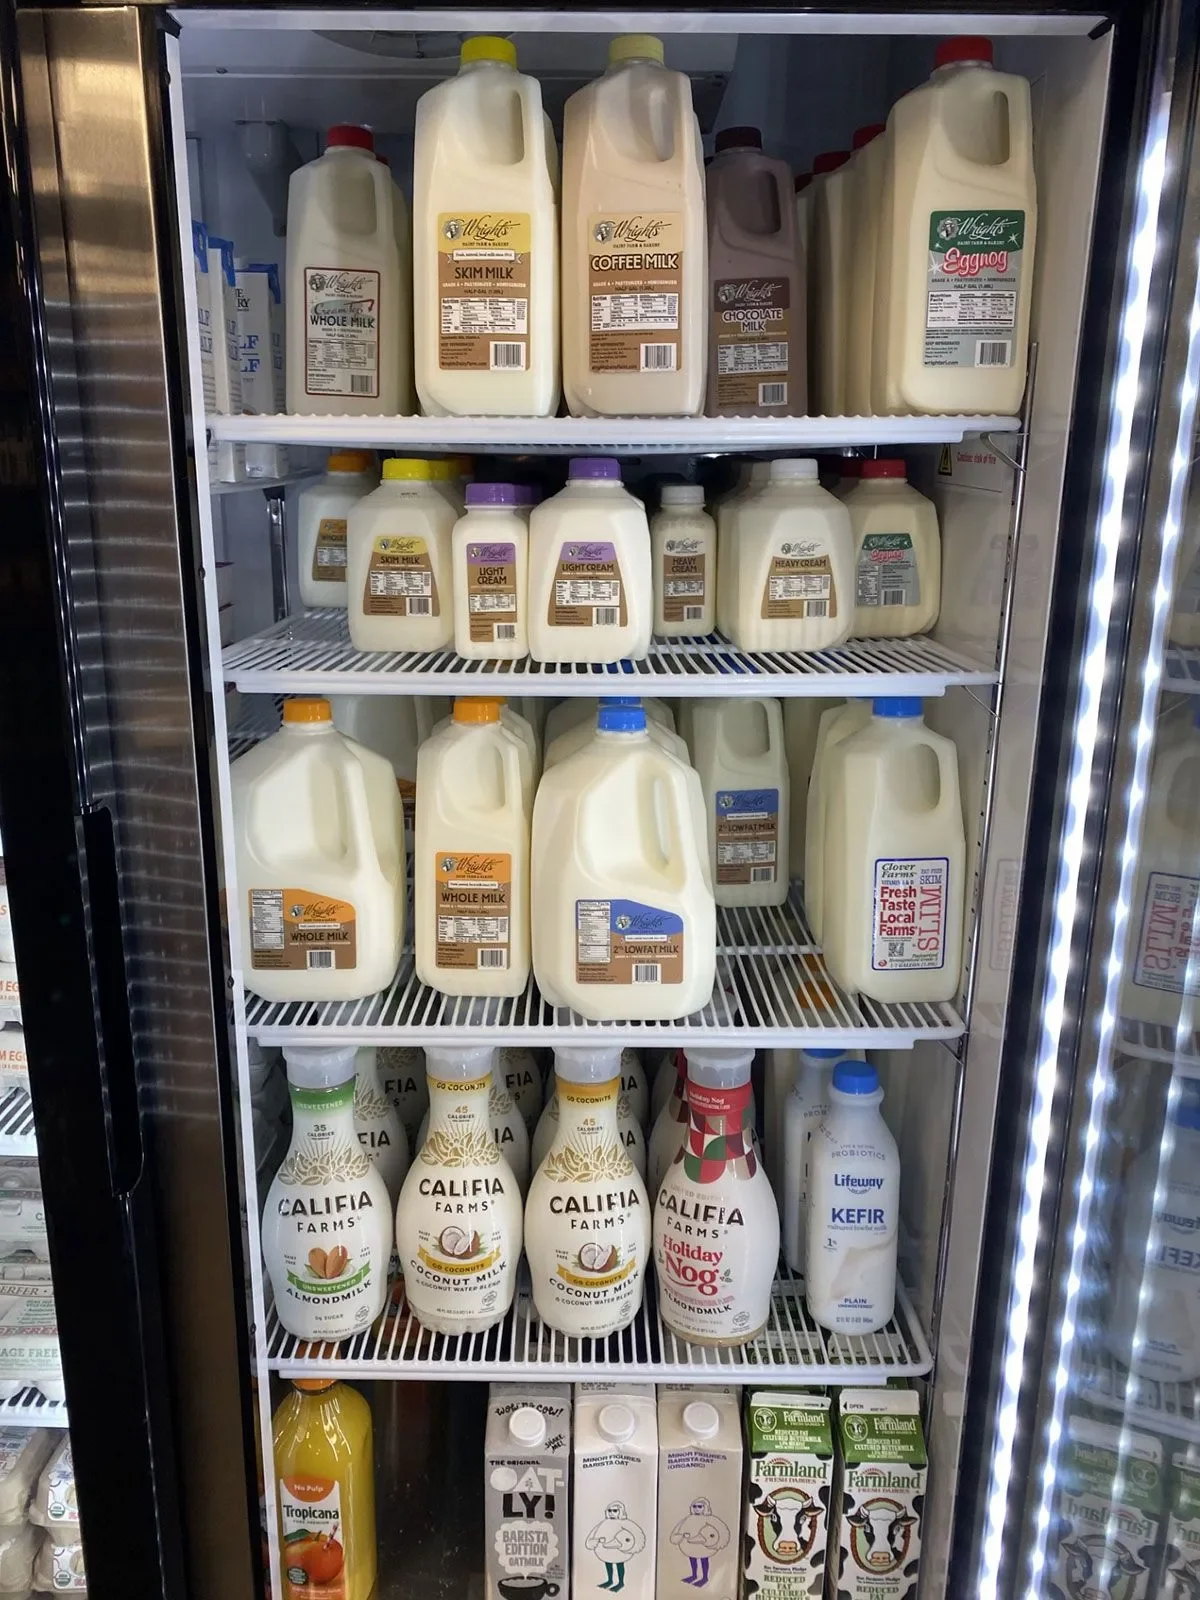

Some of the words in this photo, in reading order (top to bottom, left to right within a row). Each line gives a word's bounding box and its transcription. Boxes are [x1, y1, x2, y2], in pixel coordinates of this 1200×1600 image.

[591, 253, 642, 272] COFFEE
[644, 253, 679, 271] MILK
[942, 247, 1009, 277] Eggnog
[454, 266, 483, 280] SKIM
[485, 266, 514, 280] MILK
[310, 315, 347, 327] WHOLE
[350, 316, 376, 329] MILK
[722, 308, 783, 323] CHOCOLATE
[741, 320, 766, 332] MILK
[380, 556, 399, 564] SKIM
[402, 556, 421, 565] MILK
[673, 557, 696, 566] HEAVY
[775, 559, 799, 568] HEAVY
[800, 559, 827, 567] CREAM
[479, 567, 504, 576] LIGHT
[562, 563, 586, 572] LIGHT
[587, 563, 614, 572] CREAM
[477, 576, 507, 585] CREAM
[881, 863, 916, 871] Clover
[881, 871, 916, 879] Farms
[441, 892, 479, 903] WHOLE
[481, 893, 506, 904] MILK
[880, 885, 917, 898] Fresh
[880, 899, 916, 911] Taste
[880, 911, 915, 924] Local
[290, 932, 325, 941] WHOLE
[327, 931, 349, 941] MILK
[879, 924, 918, 936] Farms
[624, 945, 658, 954] LOWFAT
[659, 944, 679, 954] MILK
[436, 1082, 446, 1090] GO
[447, 1082, 486, 1092] COCONUTS
[455, 1105, 468, 1114] 45
[313, 1124, 327, 1132] 35
[583, 1118, 596, 1126] 45
[419, 1178, 505, 1197] CALIFIA
[834, 1173, 884, 1190] Lifeway
[278, 1190, 373, 1217] CALIFIA
[435, 1200, 489, 1214] FARMS
[549, 1188, 640, 1214] CALIFIA
[659, 1188, 744, 1226] CALIFIA
[831, 1207, 885, 1224] KEFIR
[297, 1217, 355, 1233] FARMS
[570, 1215, 625, 1230] FARMS
[666, 1216, 720, 1239] FARMS
[662, 1233, 723, 1266] Holiday
[410, 1259, 470, 1286] COCONUT
[476, 1261, 507, 1283] MILK
[444, 1263, 485, 1273] COCONUTS
[664, 1250, 719, 1296] Nog
[549, 1278, 609, 1299] COCONUT
[614, 1270, 639, 1294] MILK
[286, 1280, 372, 1305] ALMONDMILK
[664, 1288, 732, 1315] ALMONDMILK
[783, 1411, 825, 1424] Farmland
[874, 1417, 917, 1431] Farmland
[583, 1455, 608, 1463] MINOR
[609, 1454, 641, 1463] FIGURES
[694, 1451, 727, 1460] FIGURES
[583, 1460, 613, 1469] BARISTA
[755, 1461, 828, 1480] Farmland
[848, 1471, 921, 1489] Farmland
[306, 1485, 323, 1493] Pulp
[502, 1492, 555, 1519] LY!
[283, 1505, 340, 1520] Tropicana
[502, 1530, 549, 1543] BARISTA
[504, 1543, 548, 1556] EDITION
[508, 1557, 545, 1567] OATMILK
[763, 1575, 806, 1583] REDUCED
[761, 1588, 806, 1597] CULTURED
